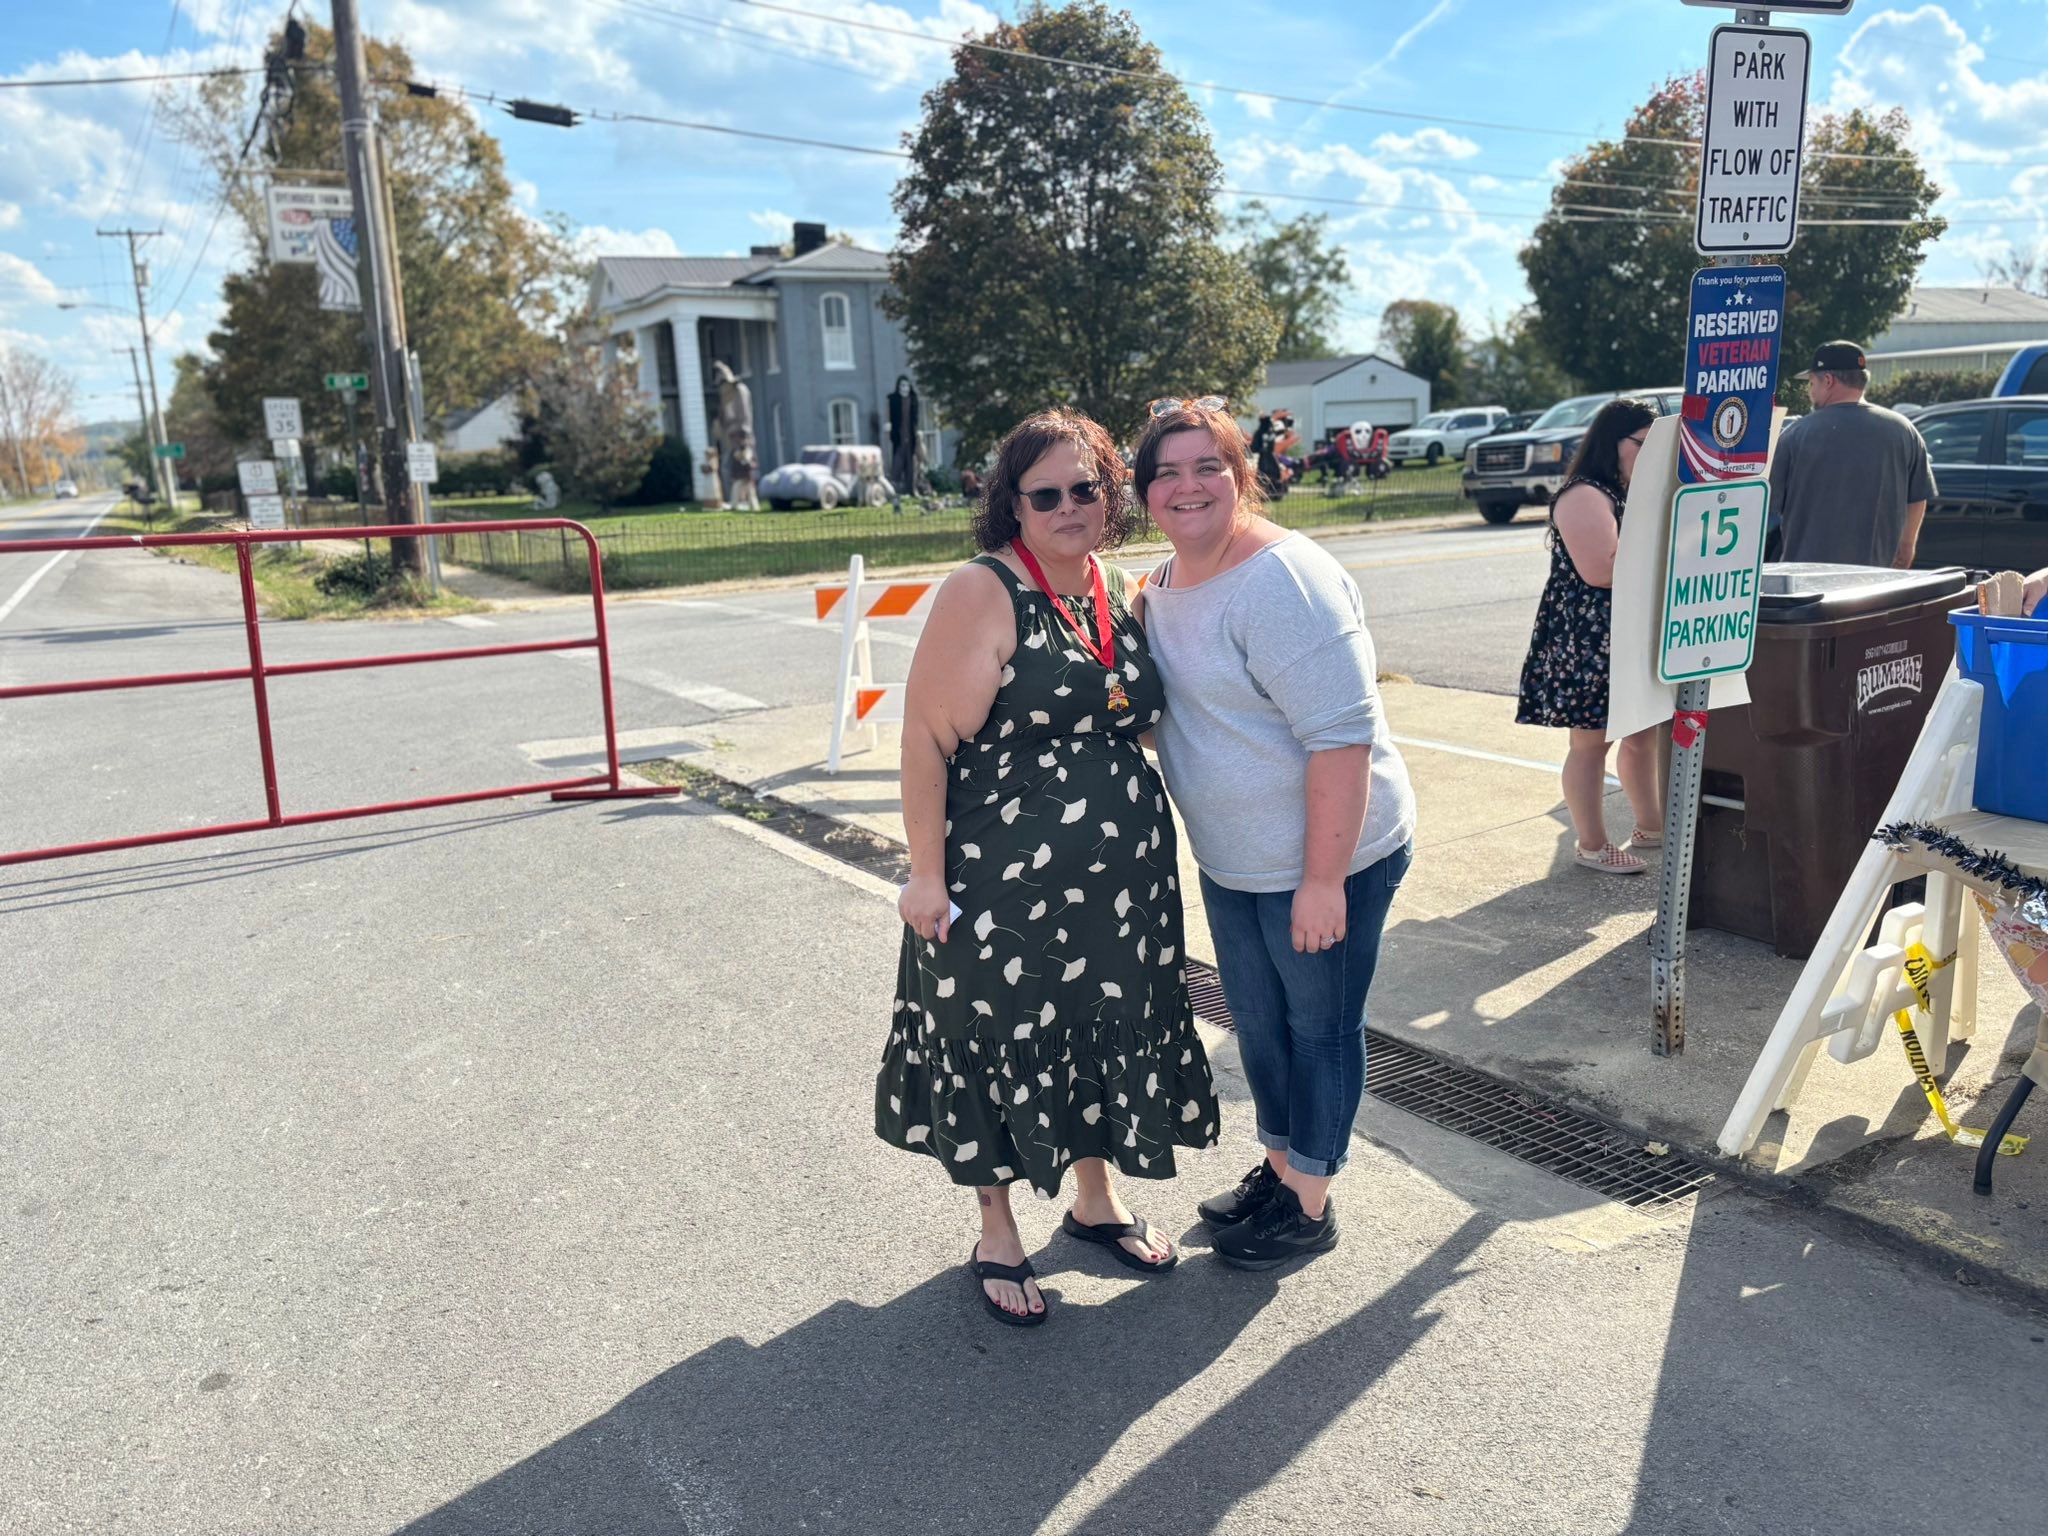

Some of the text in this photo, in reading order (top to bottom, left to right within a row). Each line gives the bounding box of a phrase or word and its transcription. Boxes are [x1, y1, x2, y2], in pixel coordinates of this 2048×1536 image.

[1733, 51, 1786, 80] PARK
[1734, 100, 1778, 128] WITH
[1709, 149, 1796, 176] FLOW OF
[1709, 196, 1787, 223] TRAFFIC
[1698, 273, 1782, 287] Thank you for your service
[1694, 309, 1779, 338] RESERVED
[1698, 338, 1772, 367] VETERAN
[1696, 365, 1768, 395] PARKING
[268, 403, 297, 411] SPEED
[275, 420, 296, 433] 35
[1700, 507, 1740, 558] 15
[1674, 568, 1754, 607] MINUTE
[1668, 610, 1750, 650] PARKING
[1857, 653, 1923, 711] RUMPKE
[1901, 1029, 1935, 1094] CAUTION
